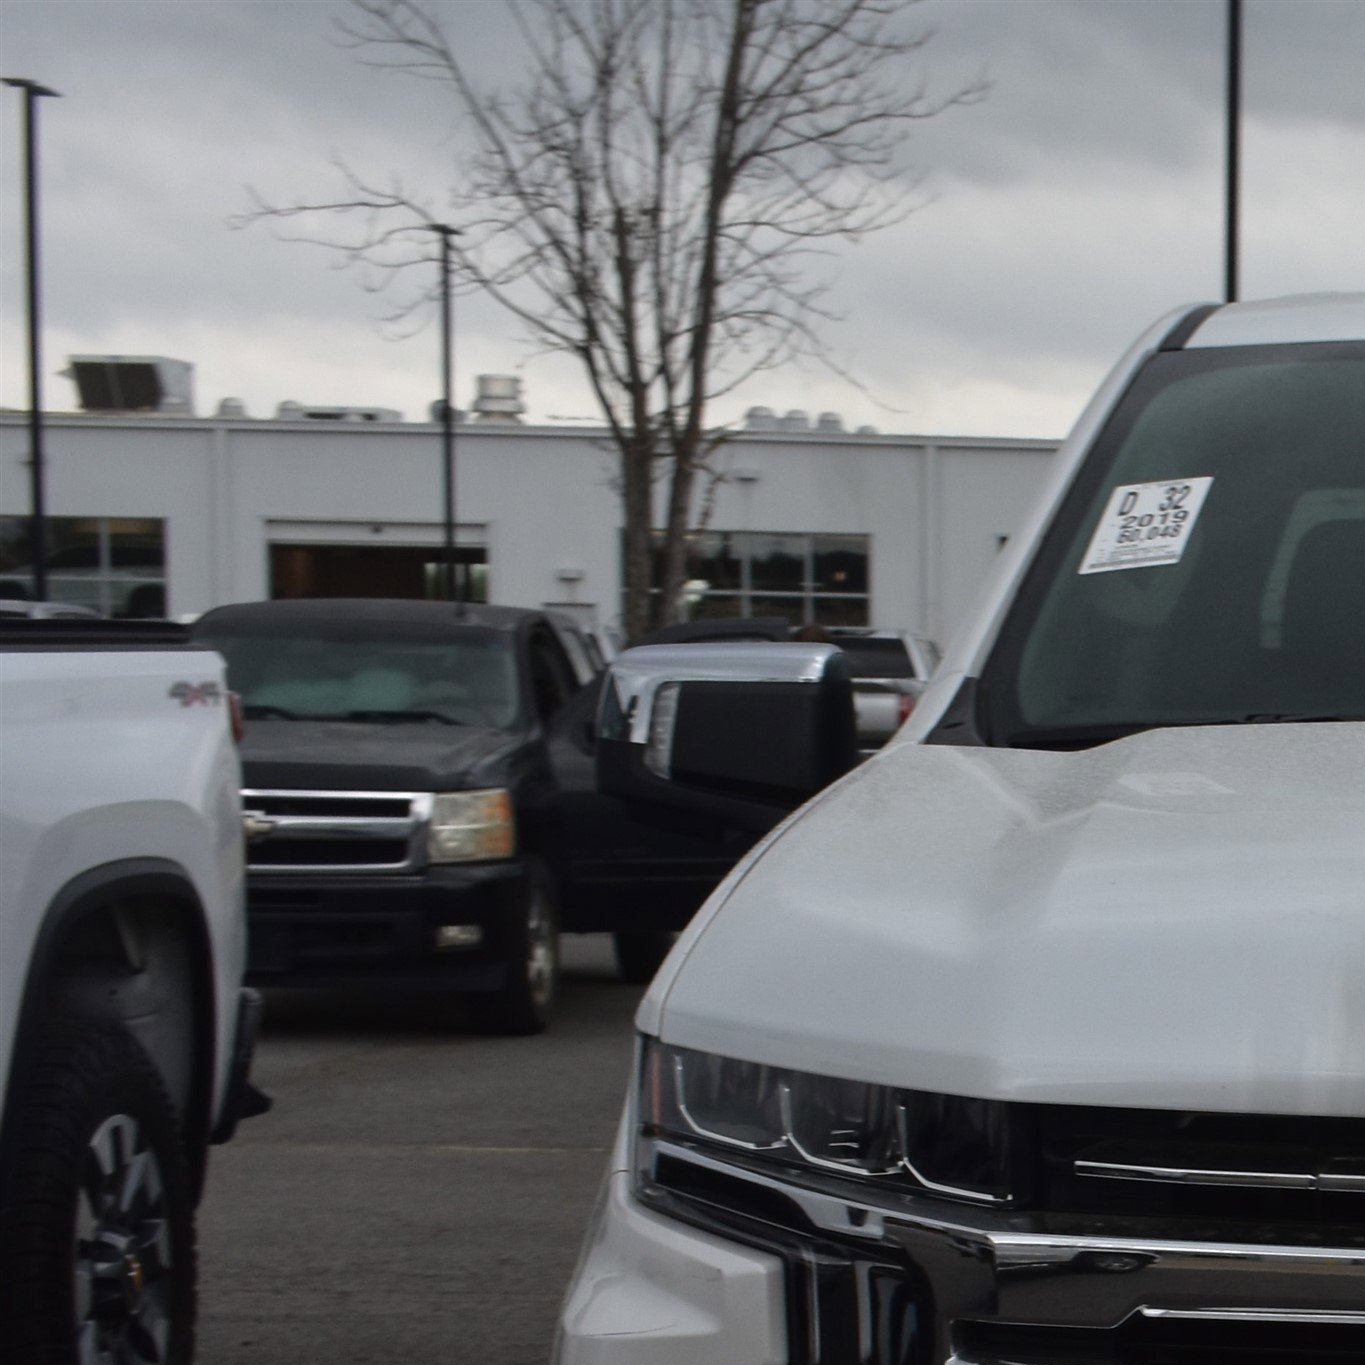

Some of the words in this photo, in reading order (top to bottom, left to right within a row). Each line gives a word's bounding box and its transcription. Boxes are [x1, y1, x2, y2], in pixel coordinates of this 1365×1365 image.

[1117, 491, 1138, 516] D
[1158, 485, 1191, 511] 32
[1119, 510, 1189, 530] 2019
